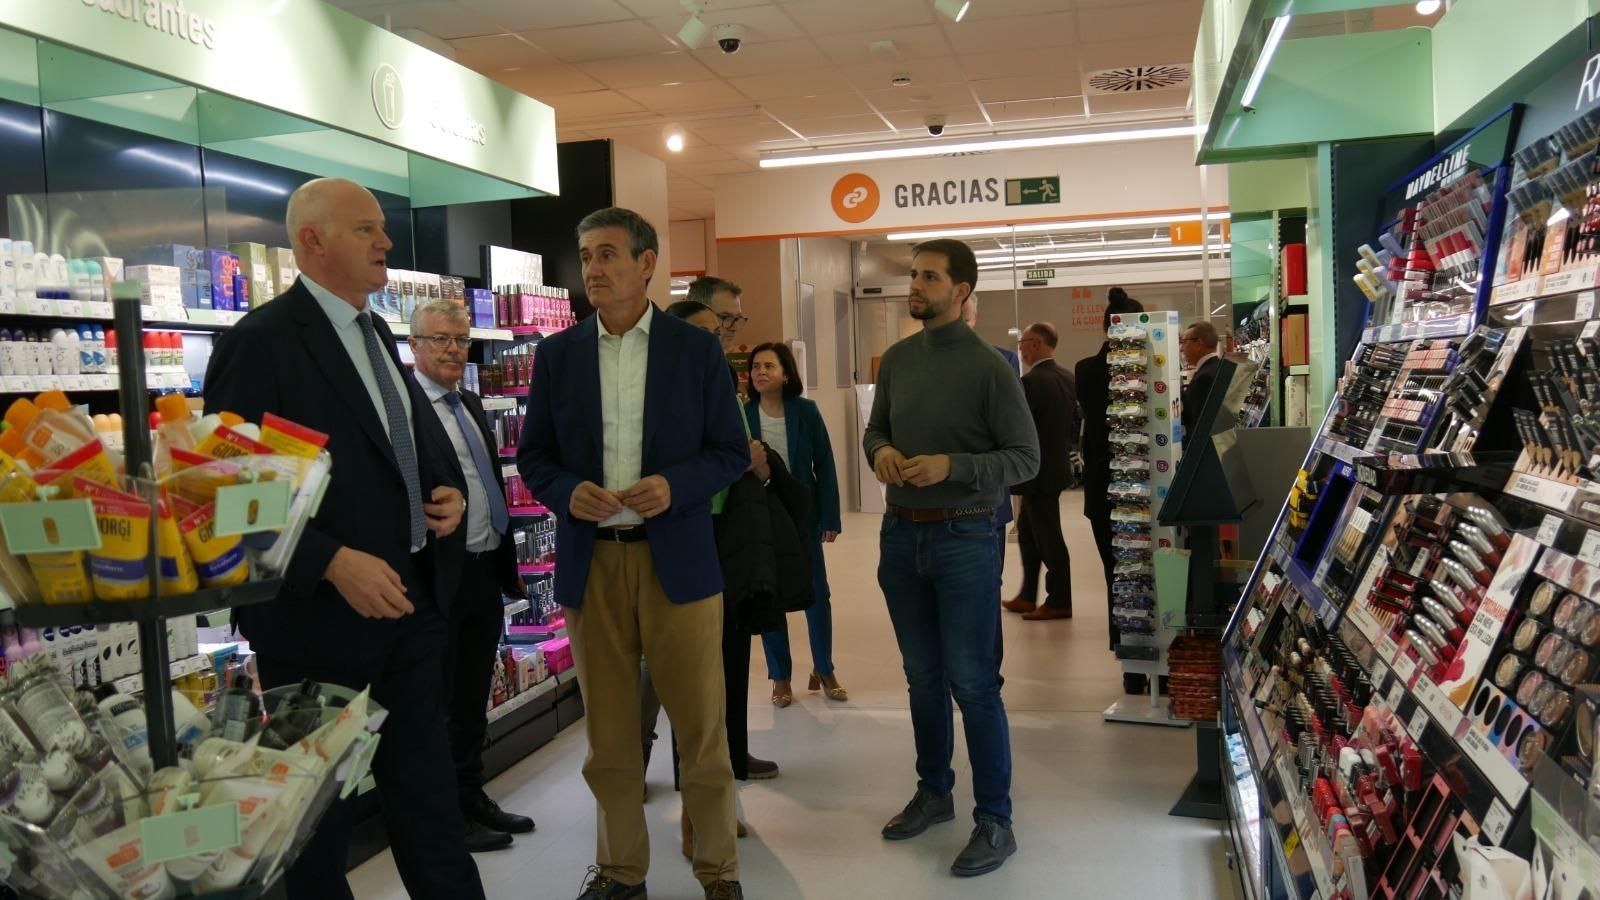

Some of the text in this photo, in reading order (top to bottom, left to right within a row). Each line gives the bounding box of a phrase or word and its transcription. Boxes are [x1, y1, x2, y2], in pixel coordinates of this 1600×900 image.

[895, 177, 999, 208] GRACIAS
[1175, 226, 1183, 241] 1
[1027, 270, 1055, 279] SALIDA
